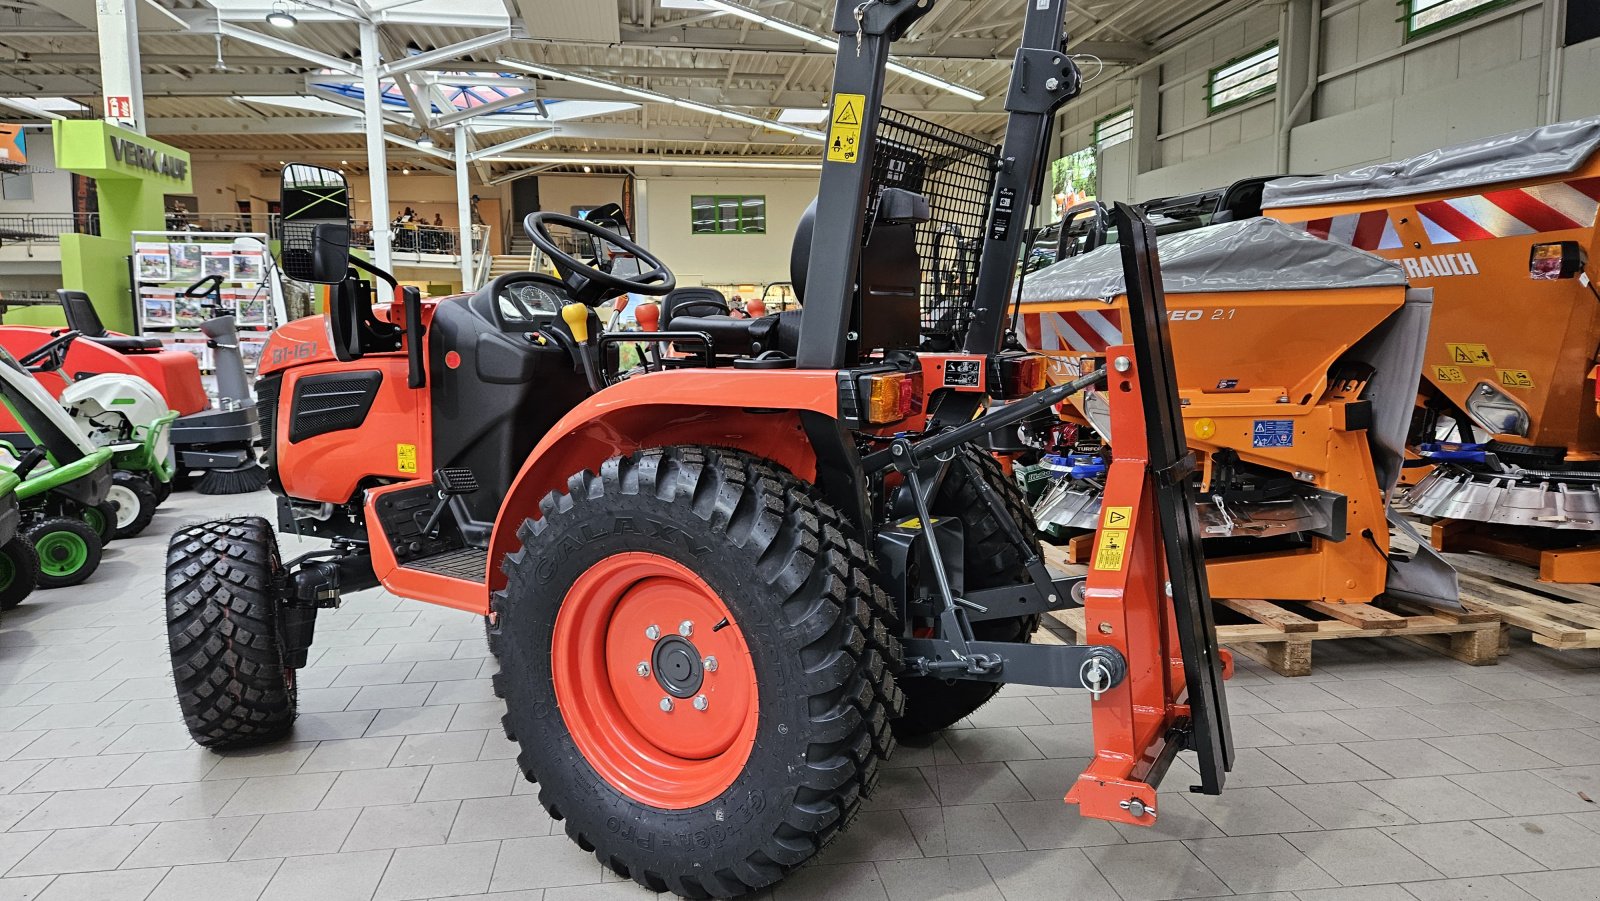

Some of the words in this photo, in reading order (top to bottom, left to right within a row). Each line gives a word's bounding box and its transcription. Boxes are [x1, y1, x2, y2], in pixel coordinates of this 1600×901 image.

[110, 135, 188, 181] VERKAUF
[1402, 252, 1479, 279] RAUCH
[1211, 308, 1236, 320] 2.1
[535, 516, 713, 586] GALAXY
